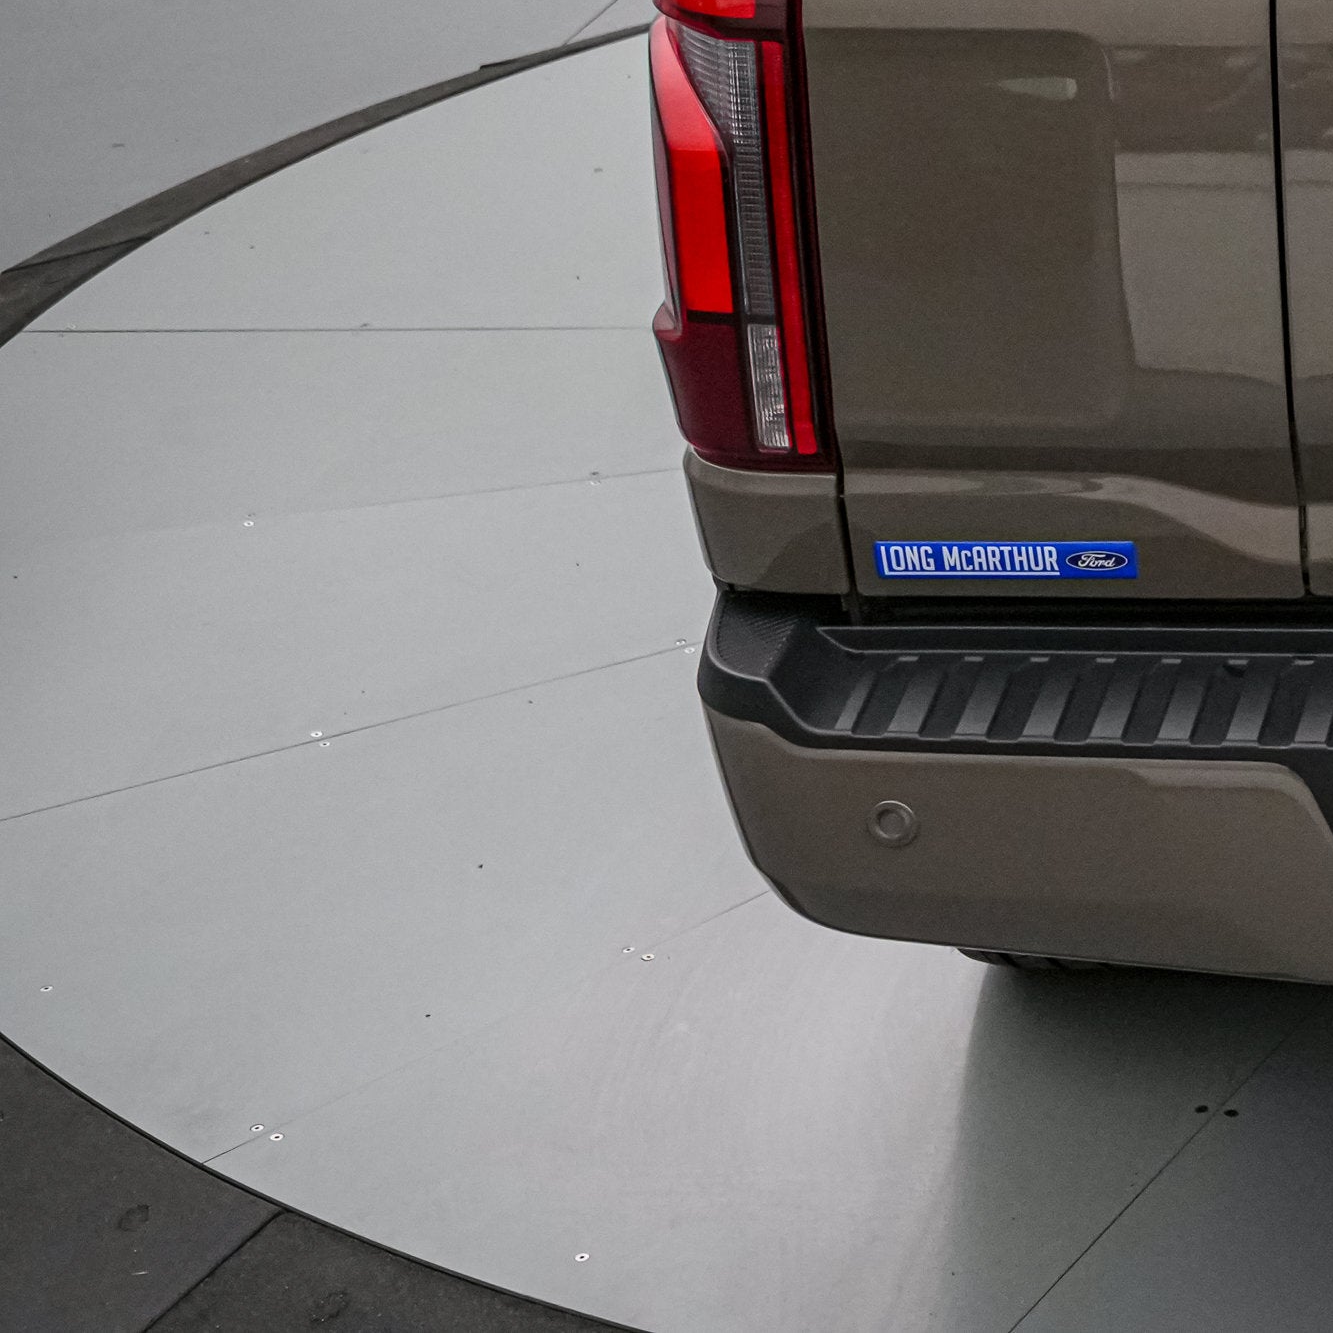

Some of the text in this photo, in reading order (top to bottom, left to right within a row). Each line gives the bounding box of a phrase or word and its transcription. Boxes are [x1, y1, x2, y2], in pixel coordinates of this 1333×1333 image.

[880, 545, 1115, 574] LONG McARTHUR Ford
